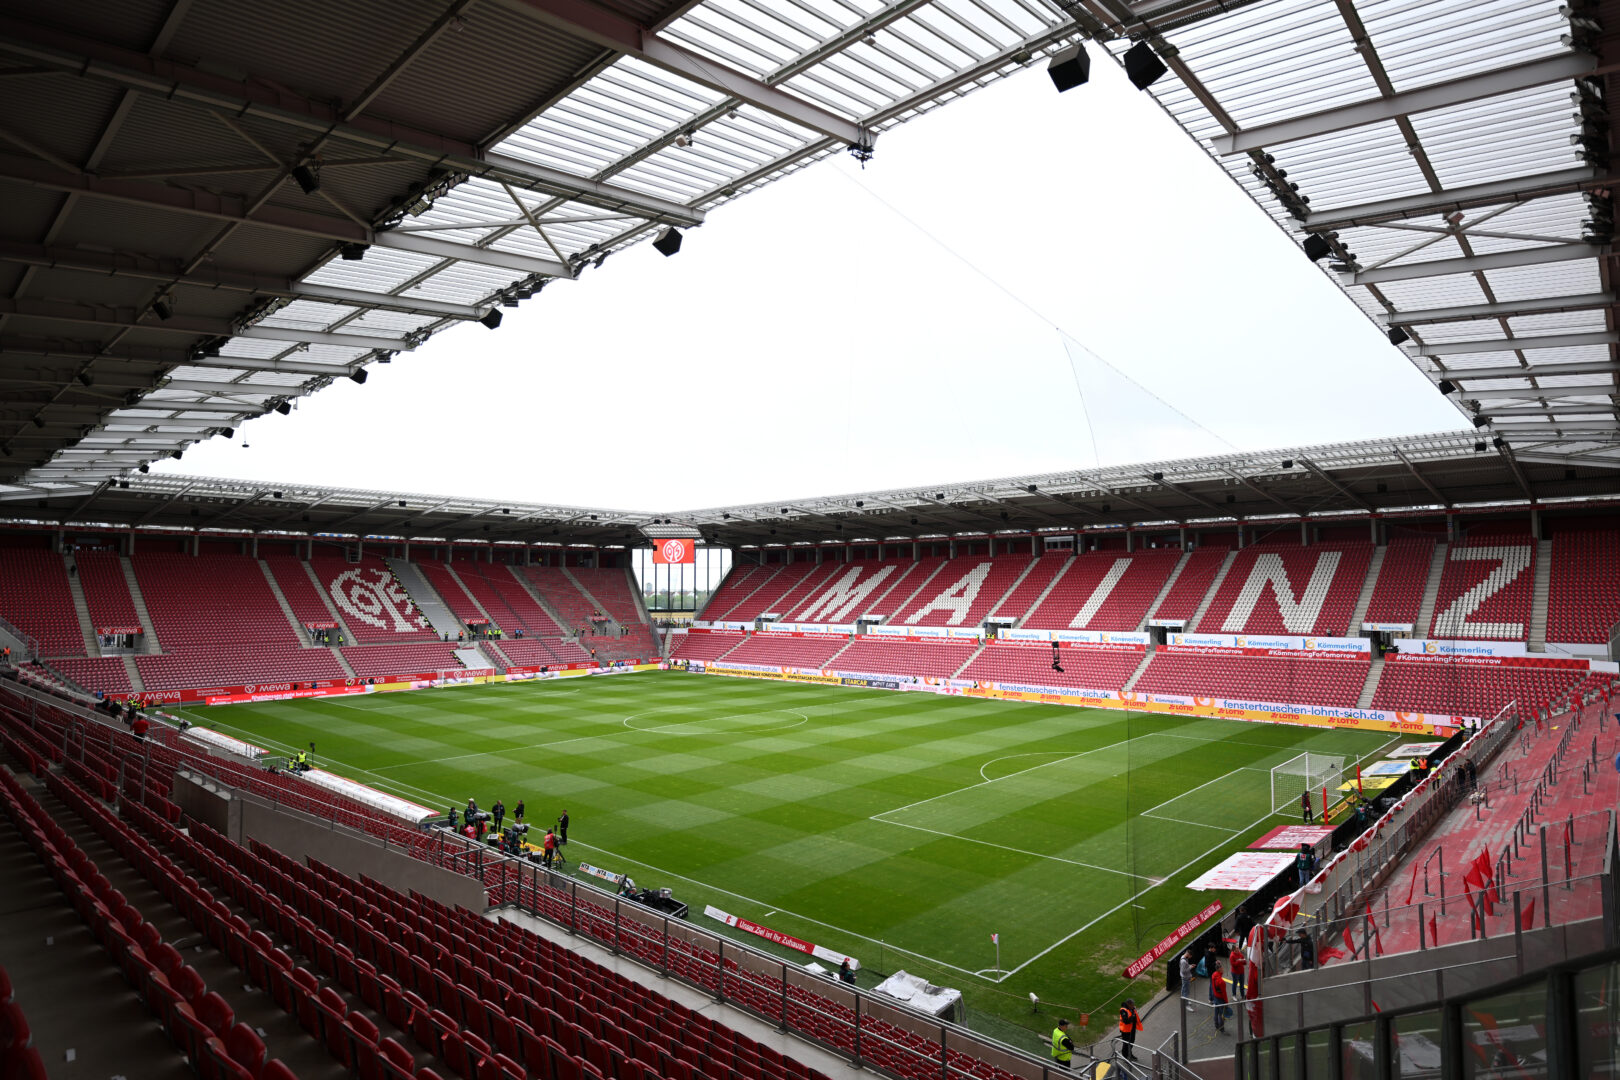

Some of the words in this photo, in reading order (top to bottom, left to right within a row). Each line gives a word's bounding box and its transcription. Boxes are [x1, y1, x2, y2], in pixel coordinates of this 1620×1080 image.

[1184, 638, 1223, 646] Kömmerling
[1248, 640, 1290, 648] Kömmerling
[1317, 642, 1364, 650] Kömmerling
[1167, 646, 1244, 655] #KömmerlingForTomorrow
[1268, 650, 1357, 659] #KömmerlingForTomorrow
[1440, 646, 1493, 655] Kömmerling
[1396, 654, 1502, 665] #KömmerlingForTomorrow
[999, 684, 1111, 699] fenstertauschen-lohnt-sich.de
[1223, 700, 1385, 720] fenstertauschen-lohnt-sich.de
[739, 920, 754, 932] Unser
[755, 926, 764, 936] Ziel
[782, 937, 807, 951] Zuhause.
[1128, 962, 1141, 977] CATS
[1141, 952, 1154, 966] DOGS
